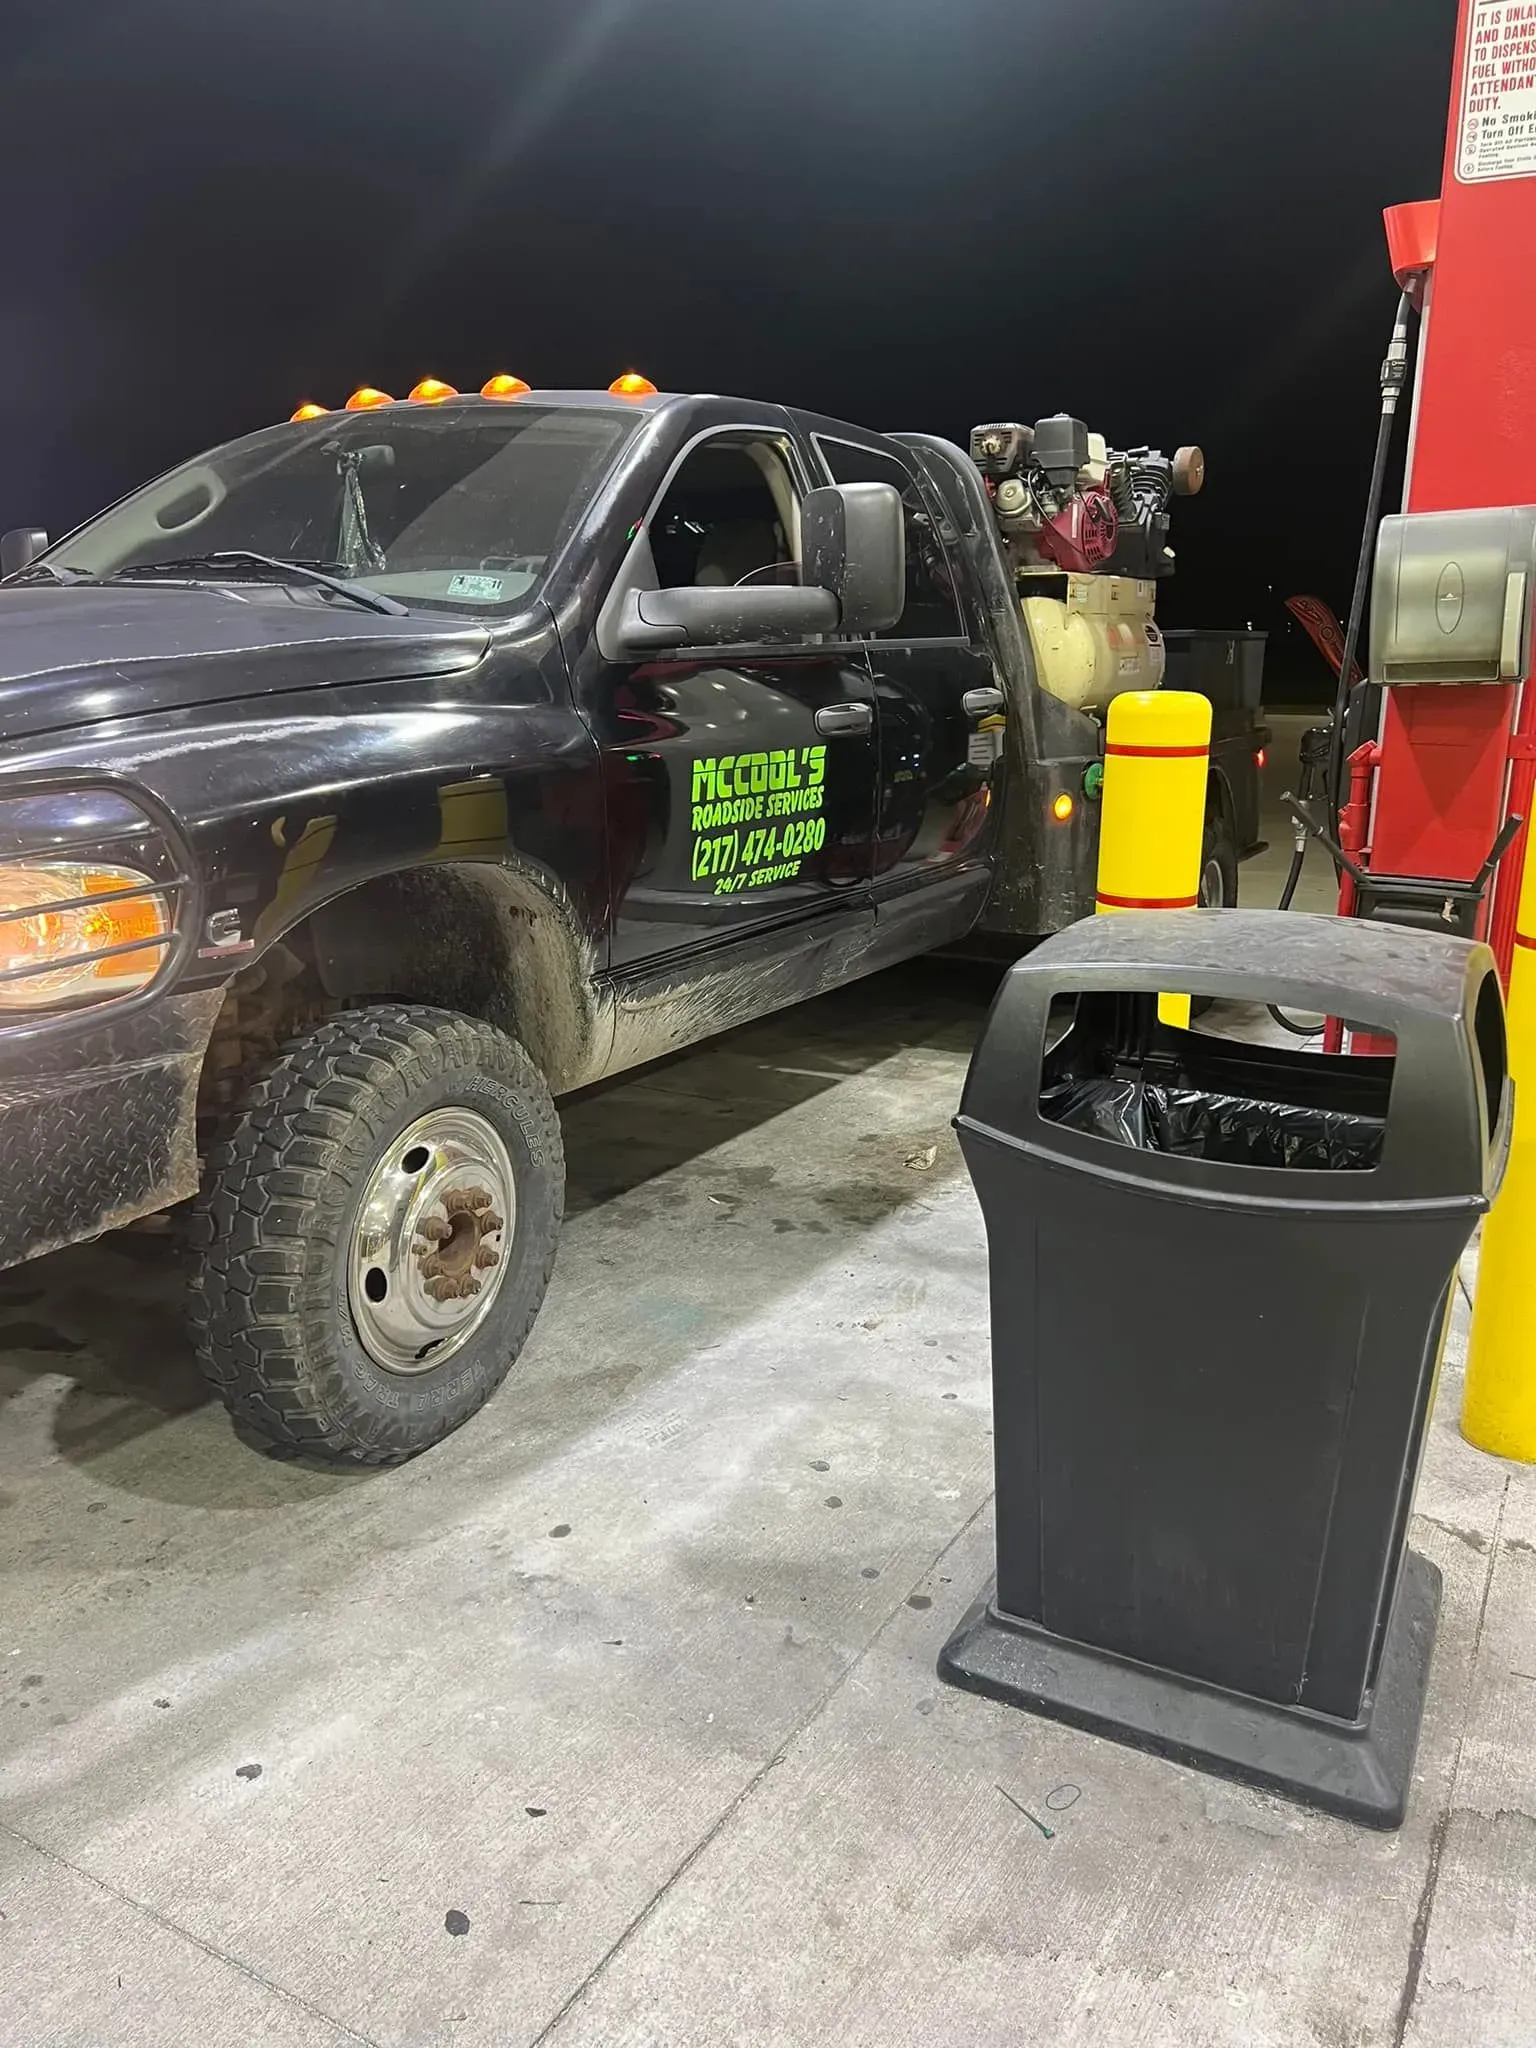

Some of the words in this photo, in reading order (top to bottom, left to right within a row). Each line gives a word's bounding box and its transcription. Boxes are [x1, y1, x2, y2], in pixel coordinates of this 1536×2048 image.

[1477, 13, 1487, 27] IT
[1491, 10, 1501, 25] IS
[1475, 29, 1499, 45] AND
[1504, 22, 1535, 40] DANG
[1474, 47, 1487, 62] TO
[1472, 63, 1496, 79] FUEL
[1469, 96, 1501, 113] DUTY.
[1481, 129, 1503, 140] Turn
[1508, 125, 1524, 136] Off
[1482, 116, 1496, 127] No
[692, 745, 827, 802] MCCOOL'S
[692, 795, 764, 832] ROADSIDE
[766, 785, 824, 817] SERVICES
[692, 829, 738, 881] (217)
[741, 817, 825, 866] 474-0280
[714, 873, 747, 895] 24/7
[748, 860, 802, 887] SERVICE
[465, 1073, 545, 1168] HERCULES
[352, 1360, 400, 1409] TRAC
